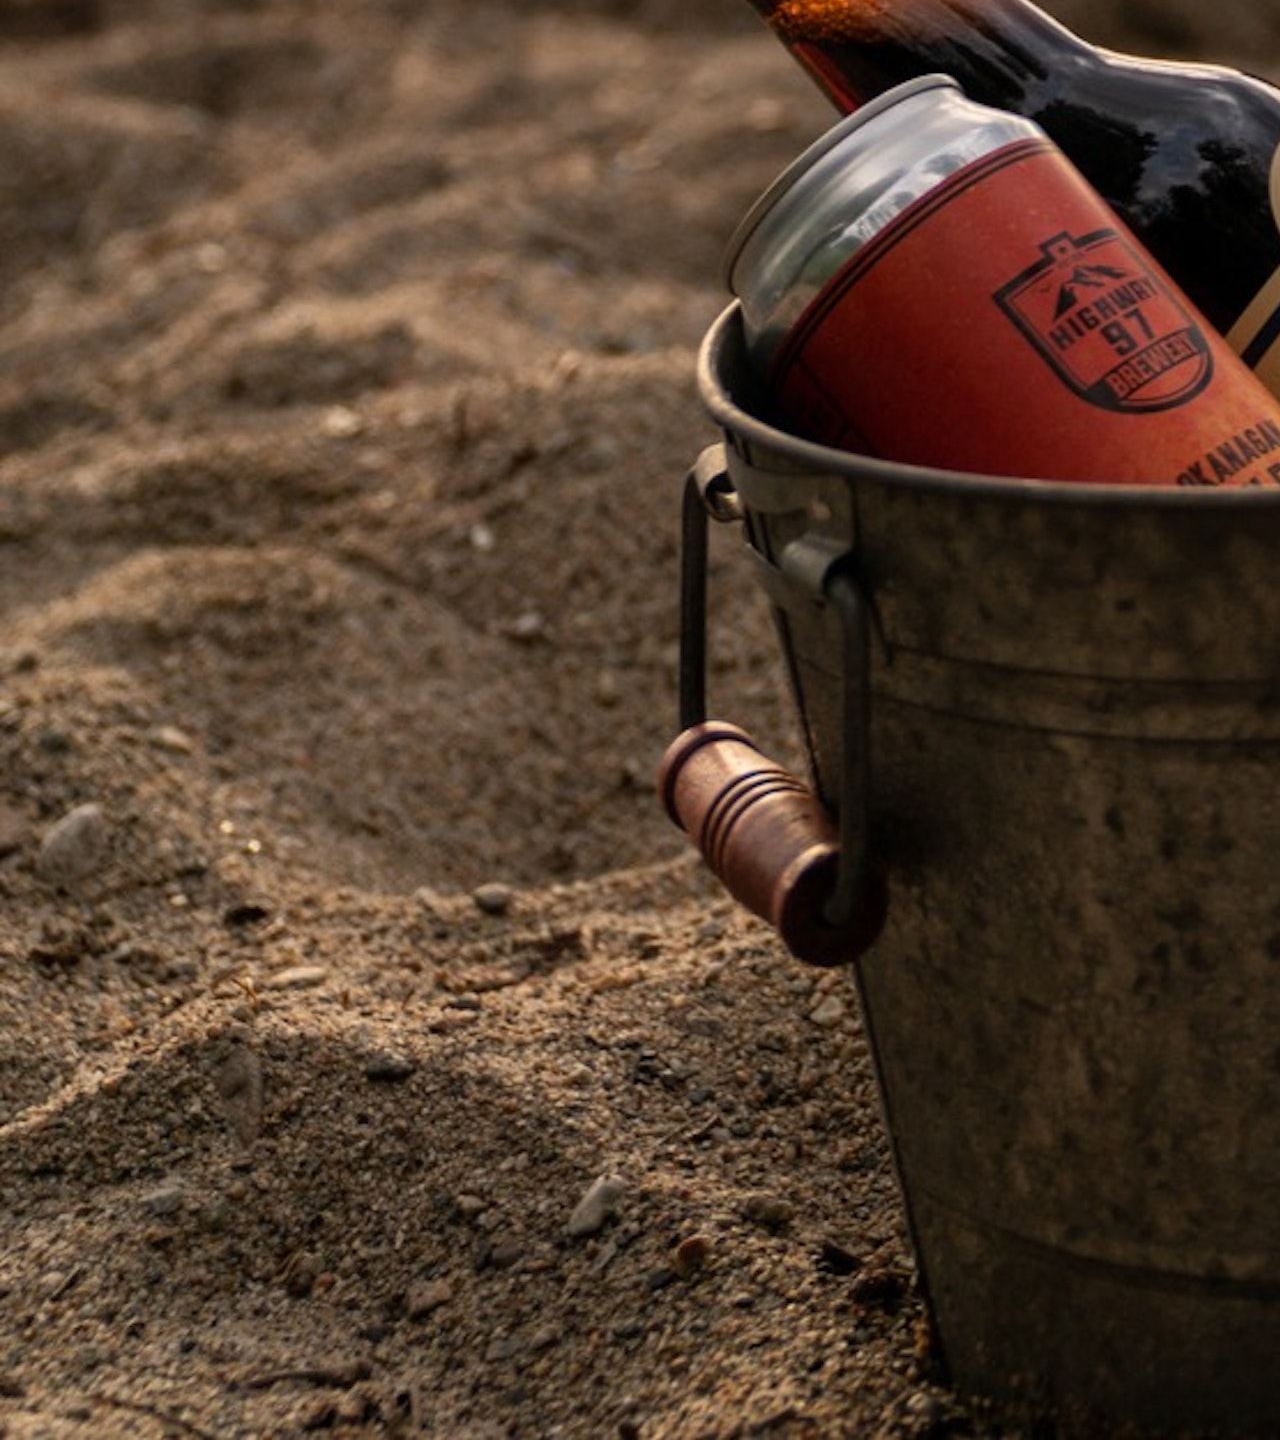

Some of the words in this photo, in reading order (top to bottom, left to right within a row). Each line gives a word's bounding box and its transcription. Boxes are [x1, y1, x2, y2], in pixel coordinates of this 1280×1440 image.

[1049, 275, 1159, 352] HIGHWAY
[1100, 307, 1154, 356] 97
[1106, 334, 1199, 396] BREWERY
